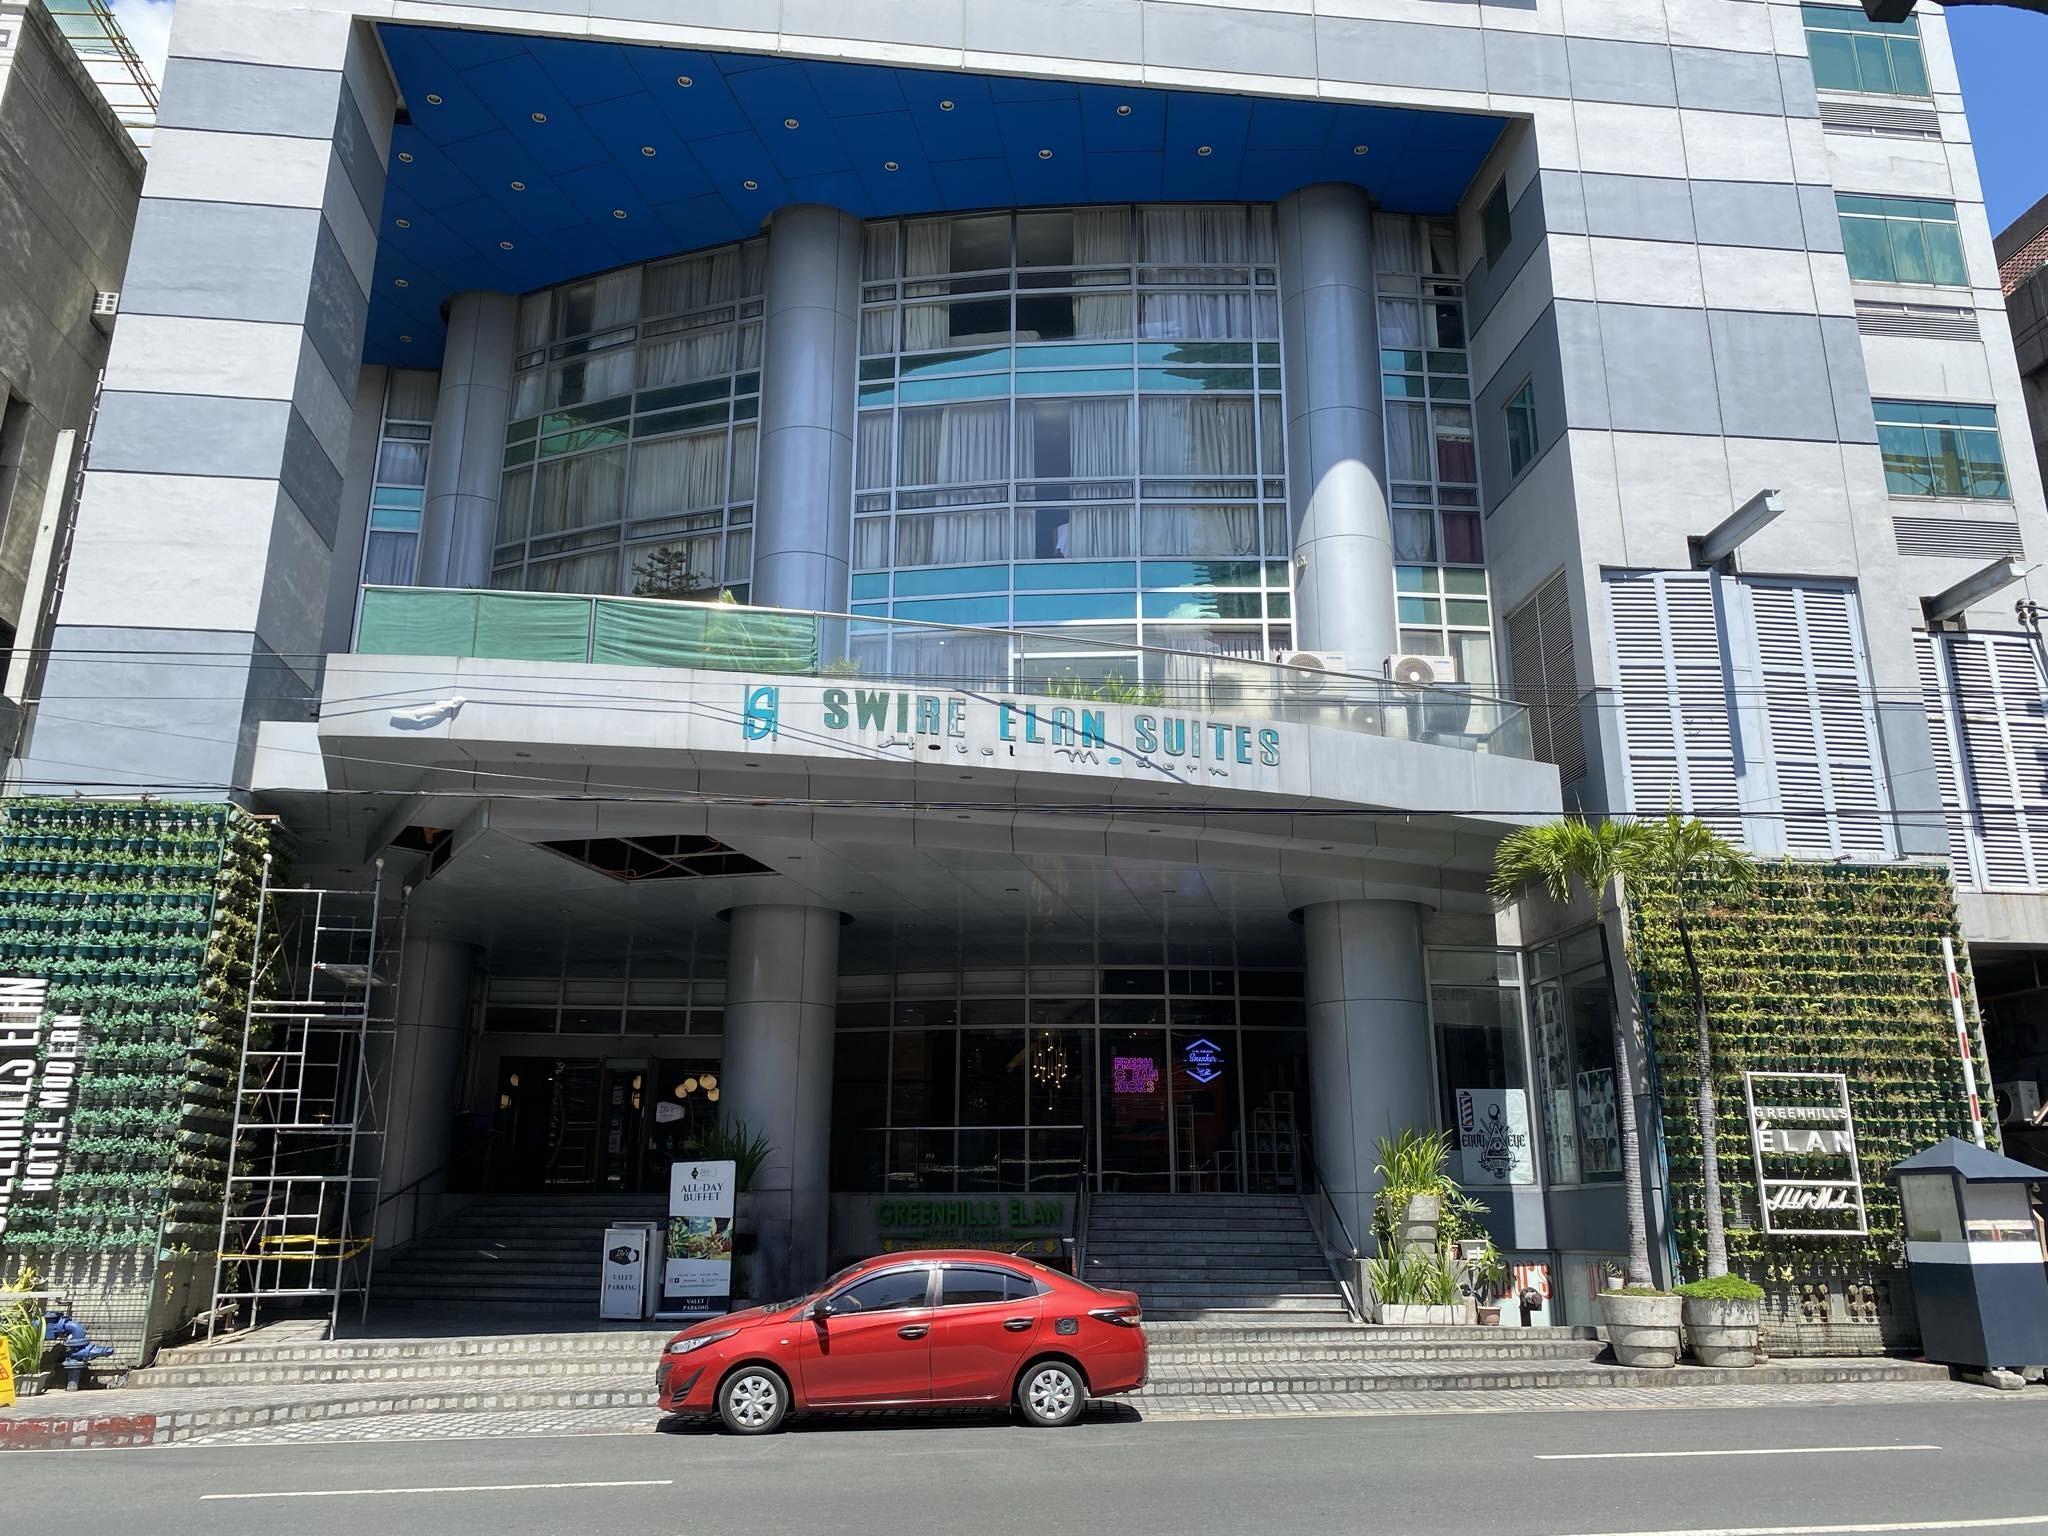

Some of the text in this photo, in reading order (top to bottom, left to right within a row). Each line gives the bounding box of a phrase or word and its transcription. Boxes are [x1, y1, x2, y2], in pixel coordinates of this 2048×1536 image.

[823, 688, 1280, 767] SWIRE ELAN SUITES
[1114, 1057, 1153, 1070] FRESH
[1114, 1080, 1155, 1093] KICKS
[21, 1014, 84, 1192] HOTEL MODERN
[1754, 1107, 1849, 1119] GREENHILLS
[1757, 1120, 1852, 1152] ÉLAN
[681, 1183, 723, 1193] ALL-DAY
[683, 1192, 719, 1202] BUFFET
[879, 1200, 1000, 1225] GREENHILLS
